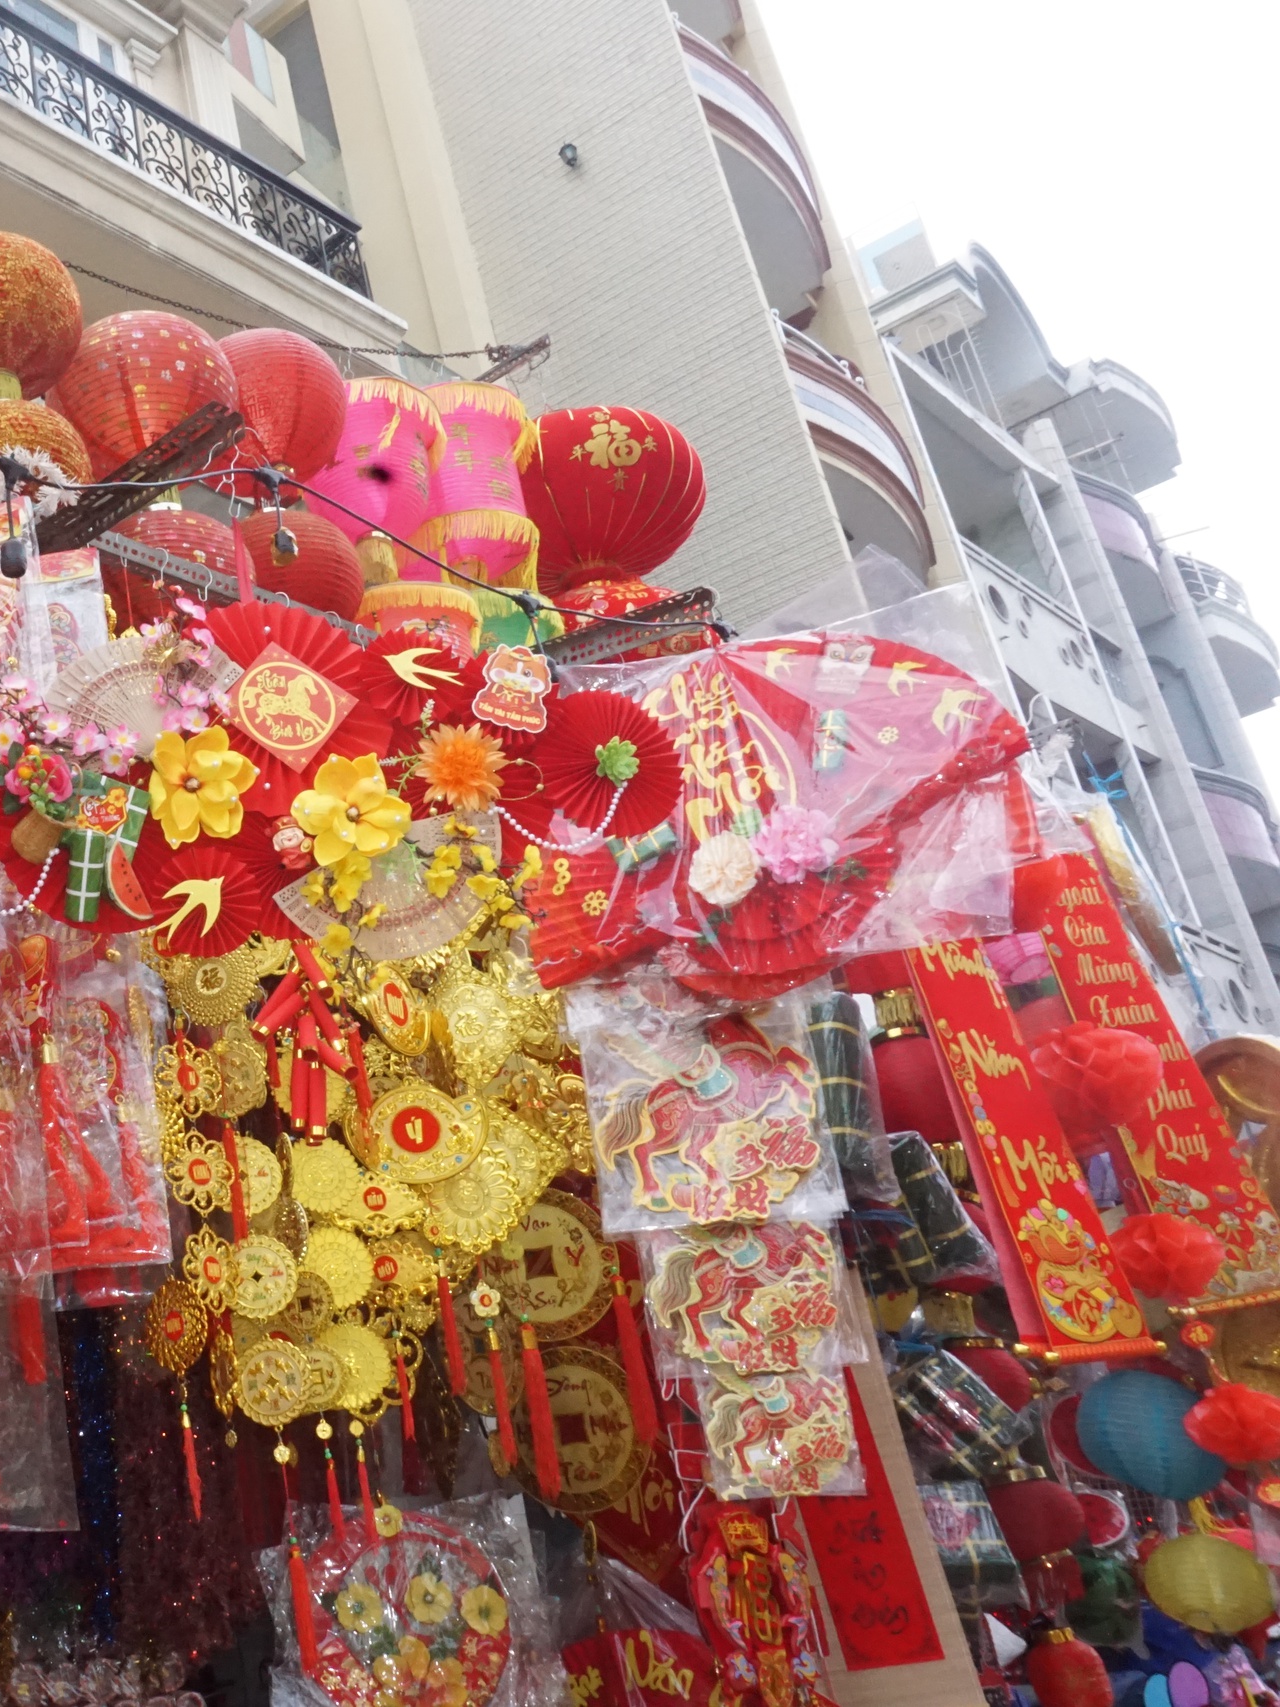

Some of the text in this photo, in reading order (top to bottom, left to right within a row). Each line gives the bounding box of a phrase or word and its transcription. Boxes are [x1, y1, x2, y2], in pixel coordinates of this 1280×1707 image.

[569, 444, 587, 461] 平
[584, 419, 642, 469] 福
[642, 435, 658, 452] 安
[1056, 877, 1104, 908] goài
[1063, 914, 1110, 948] Cửa
[1075, 952, 1138, 990] Mừng
[1089, 994, 1160, 1029] Xuân
[956, 1027, 1032, 1091] Năm
[733, 1116, 819, 1178] 多福
[1156, 1122, 1210, 1165] Quý
[1000, 1134, 1070, 1200] Mới
[769, 1282, 838, 1335] 多福
